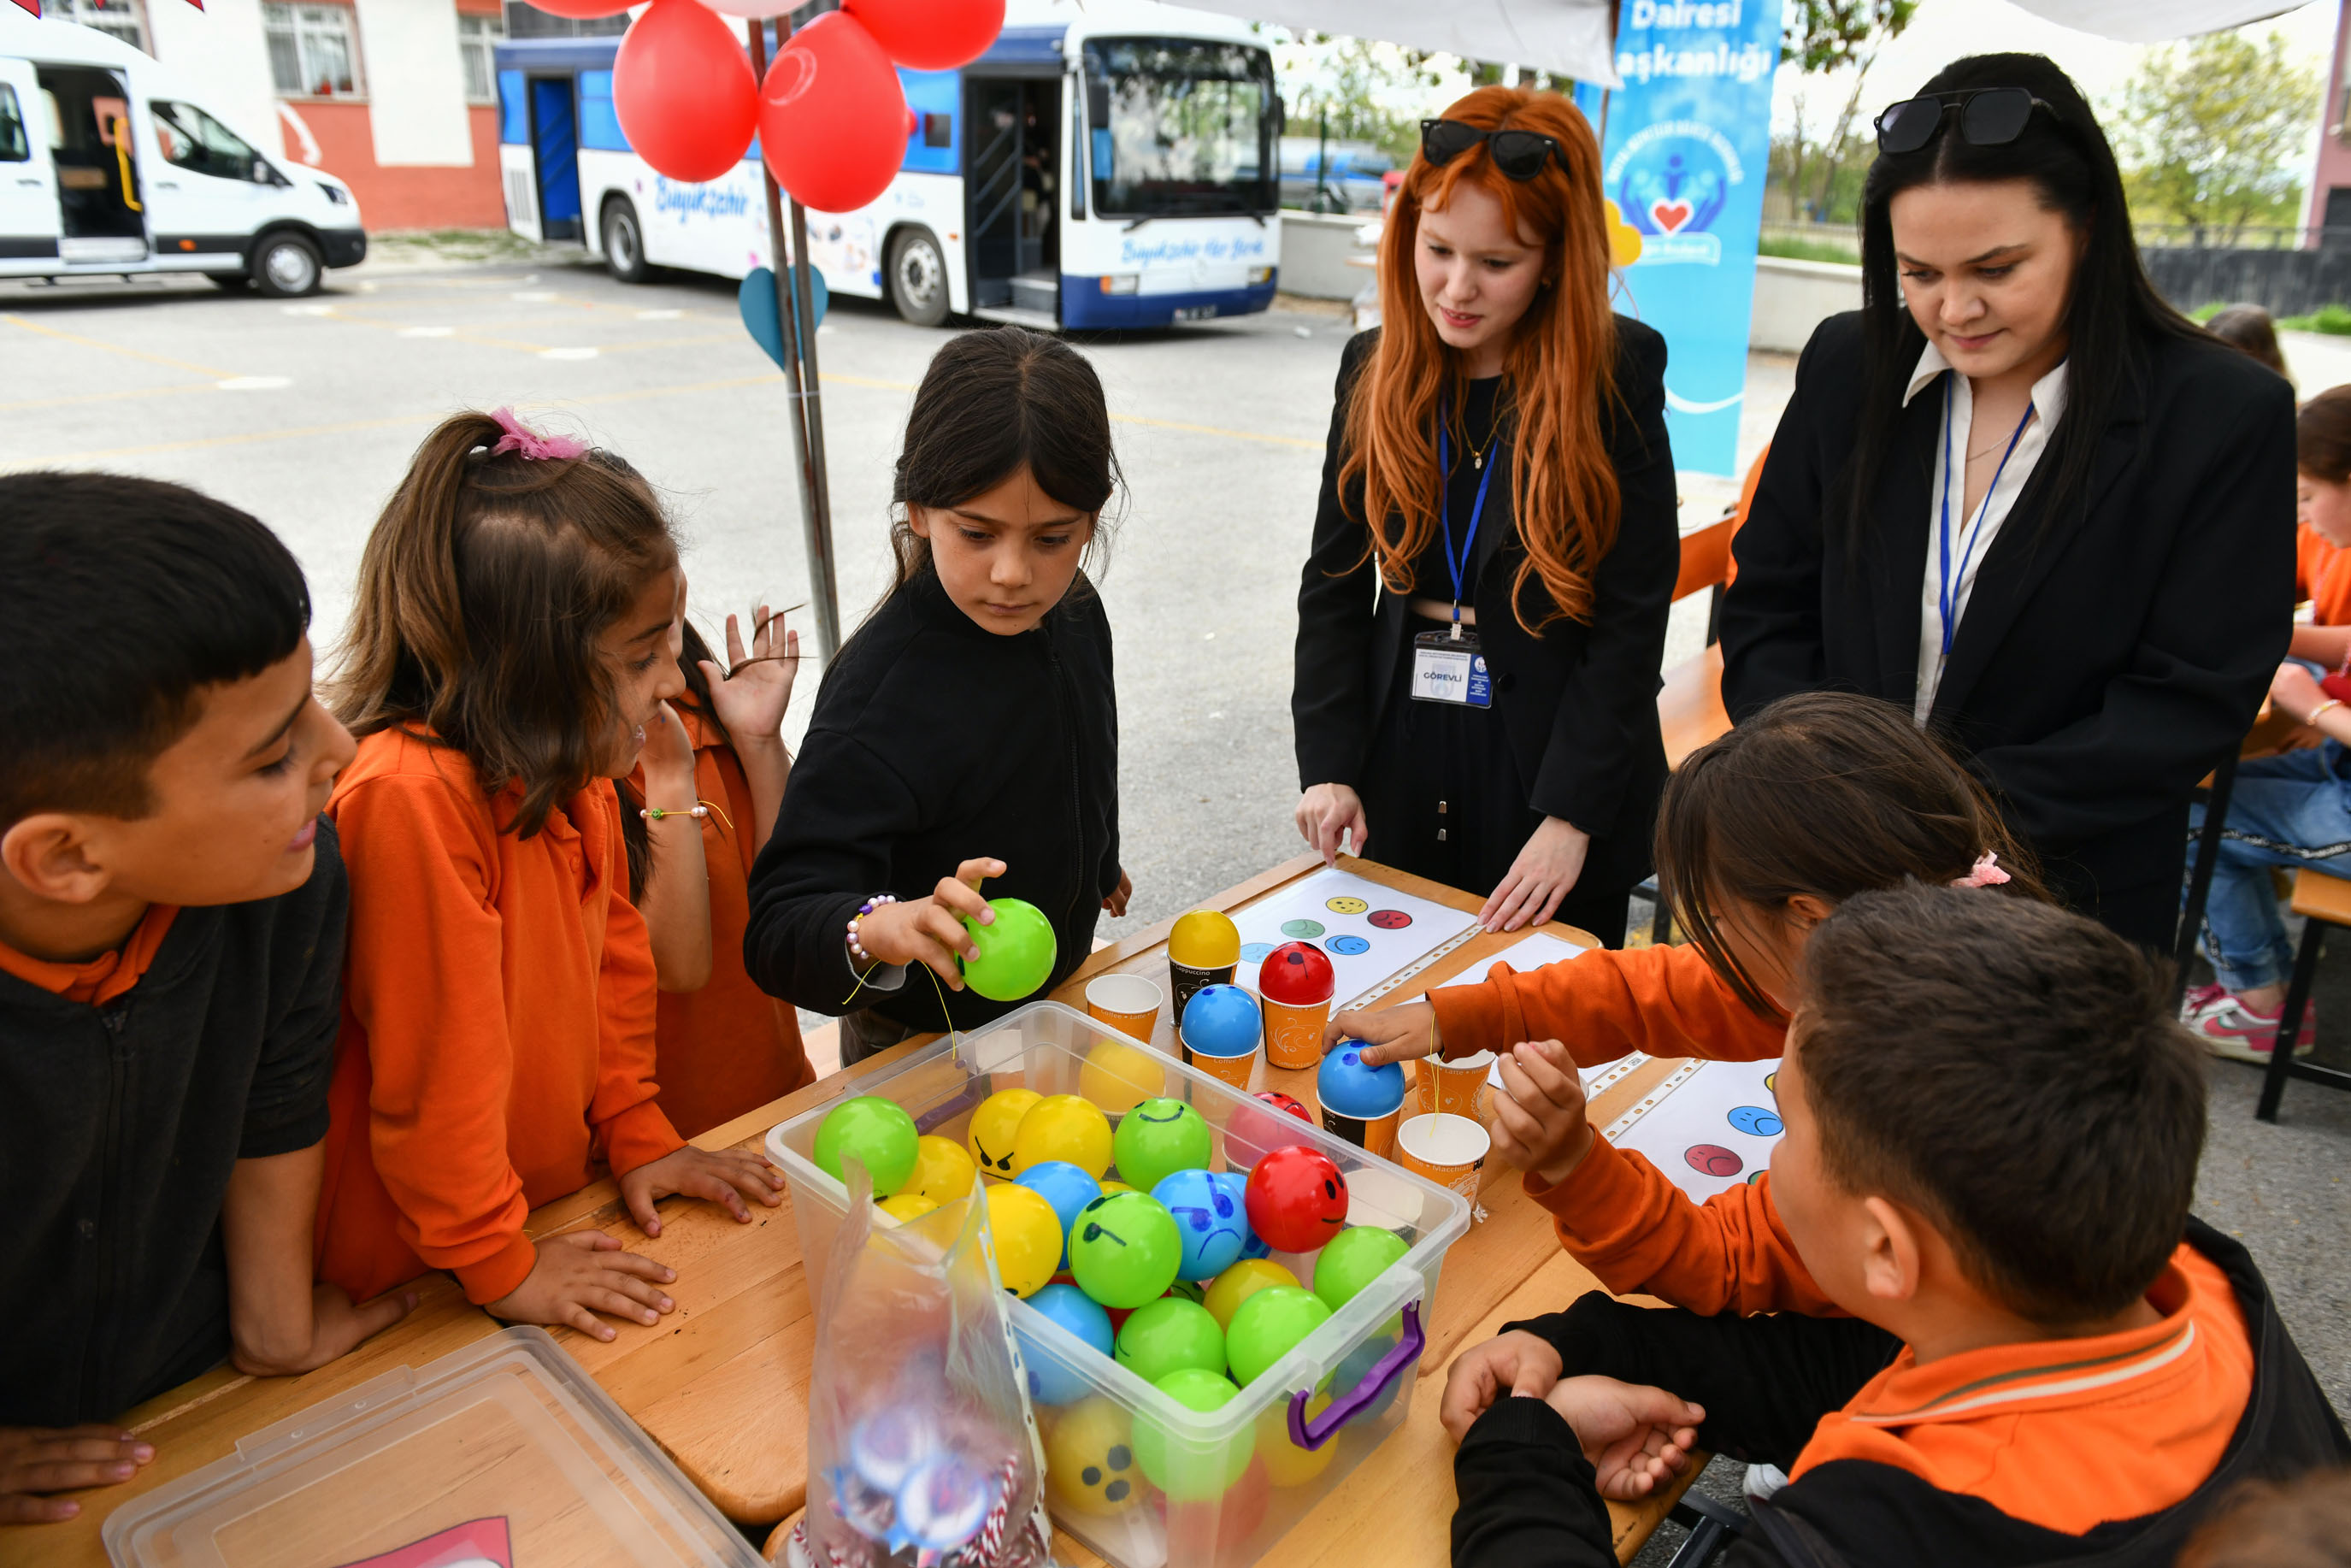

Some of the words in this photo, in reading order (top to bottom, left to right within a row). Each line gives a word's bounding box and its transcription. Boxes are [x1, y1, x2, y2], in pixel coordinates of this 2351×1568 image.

[1631, 0, 1742, 29] Dairesi
[1617, 43, 1772, 84] aşkanlığı
[1423, 671, 1462, 682] GÖREVLİ
